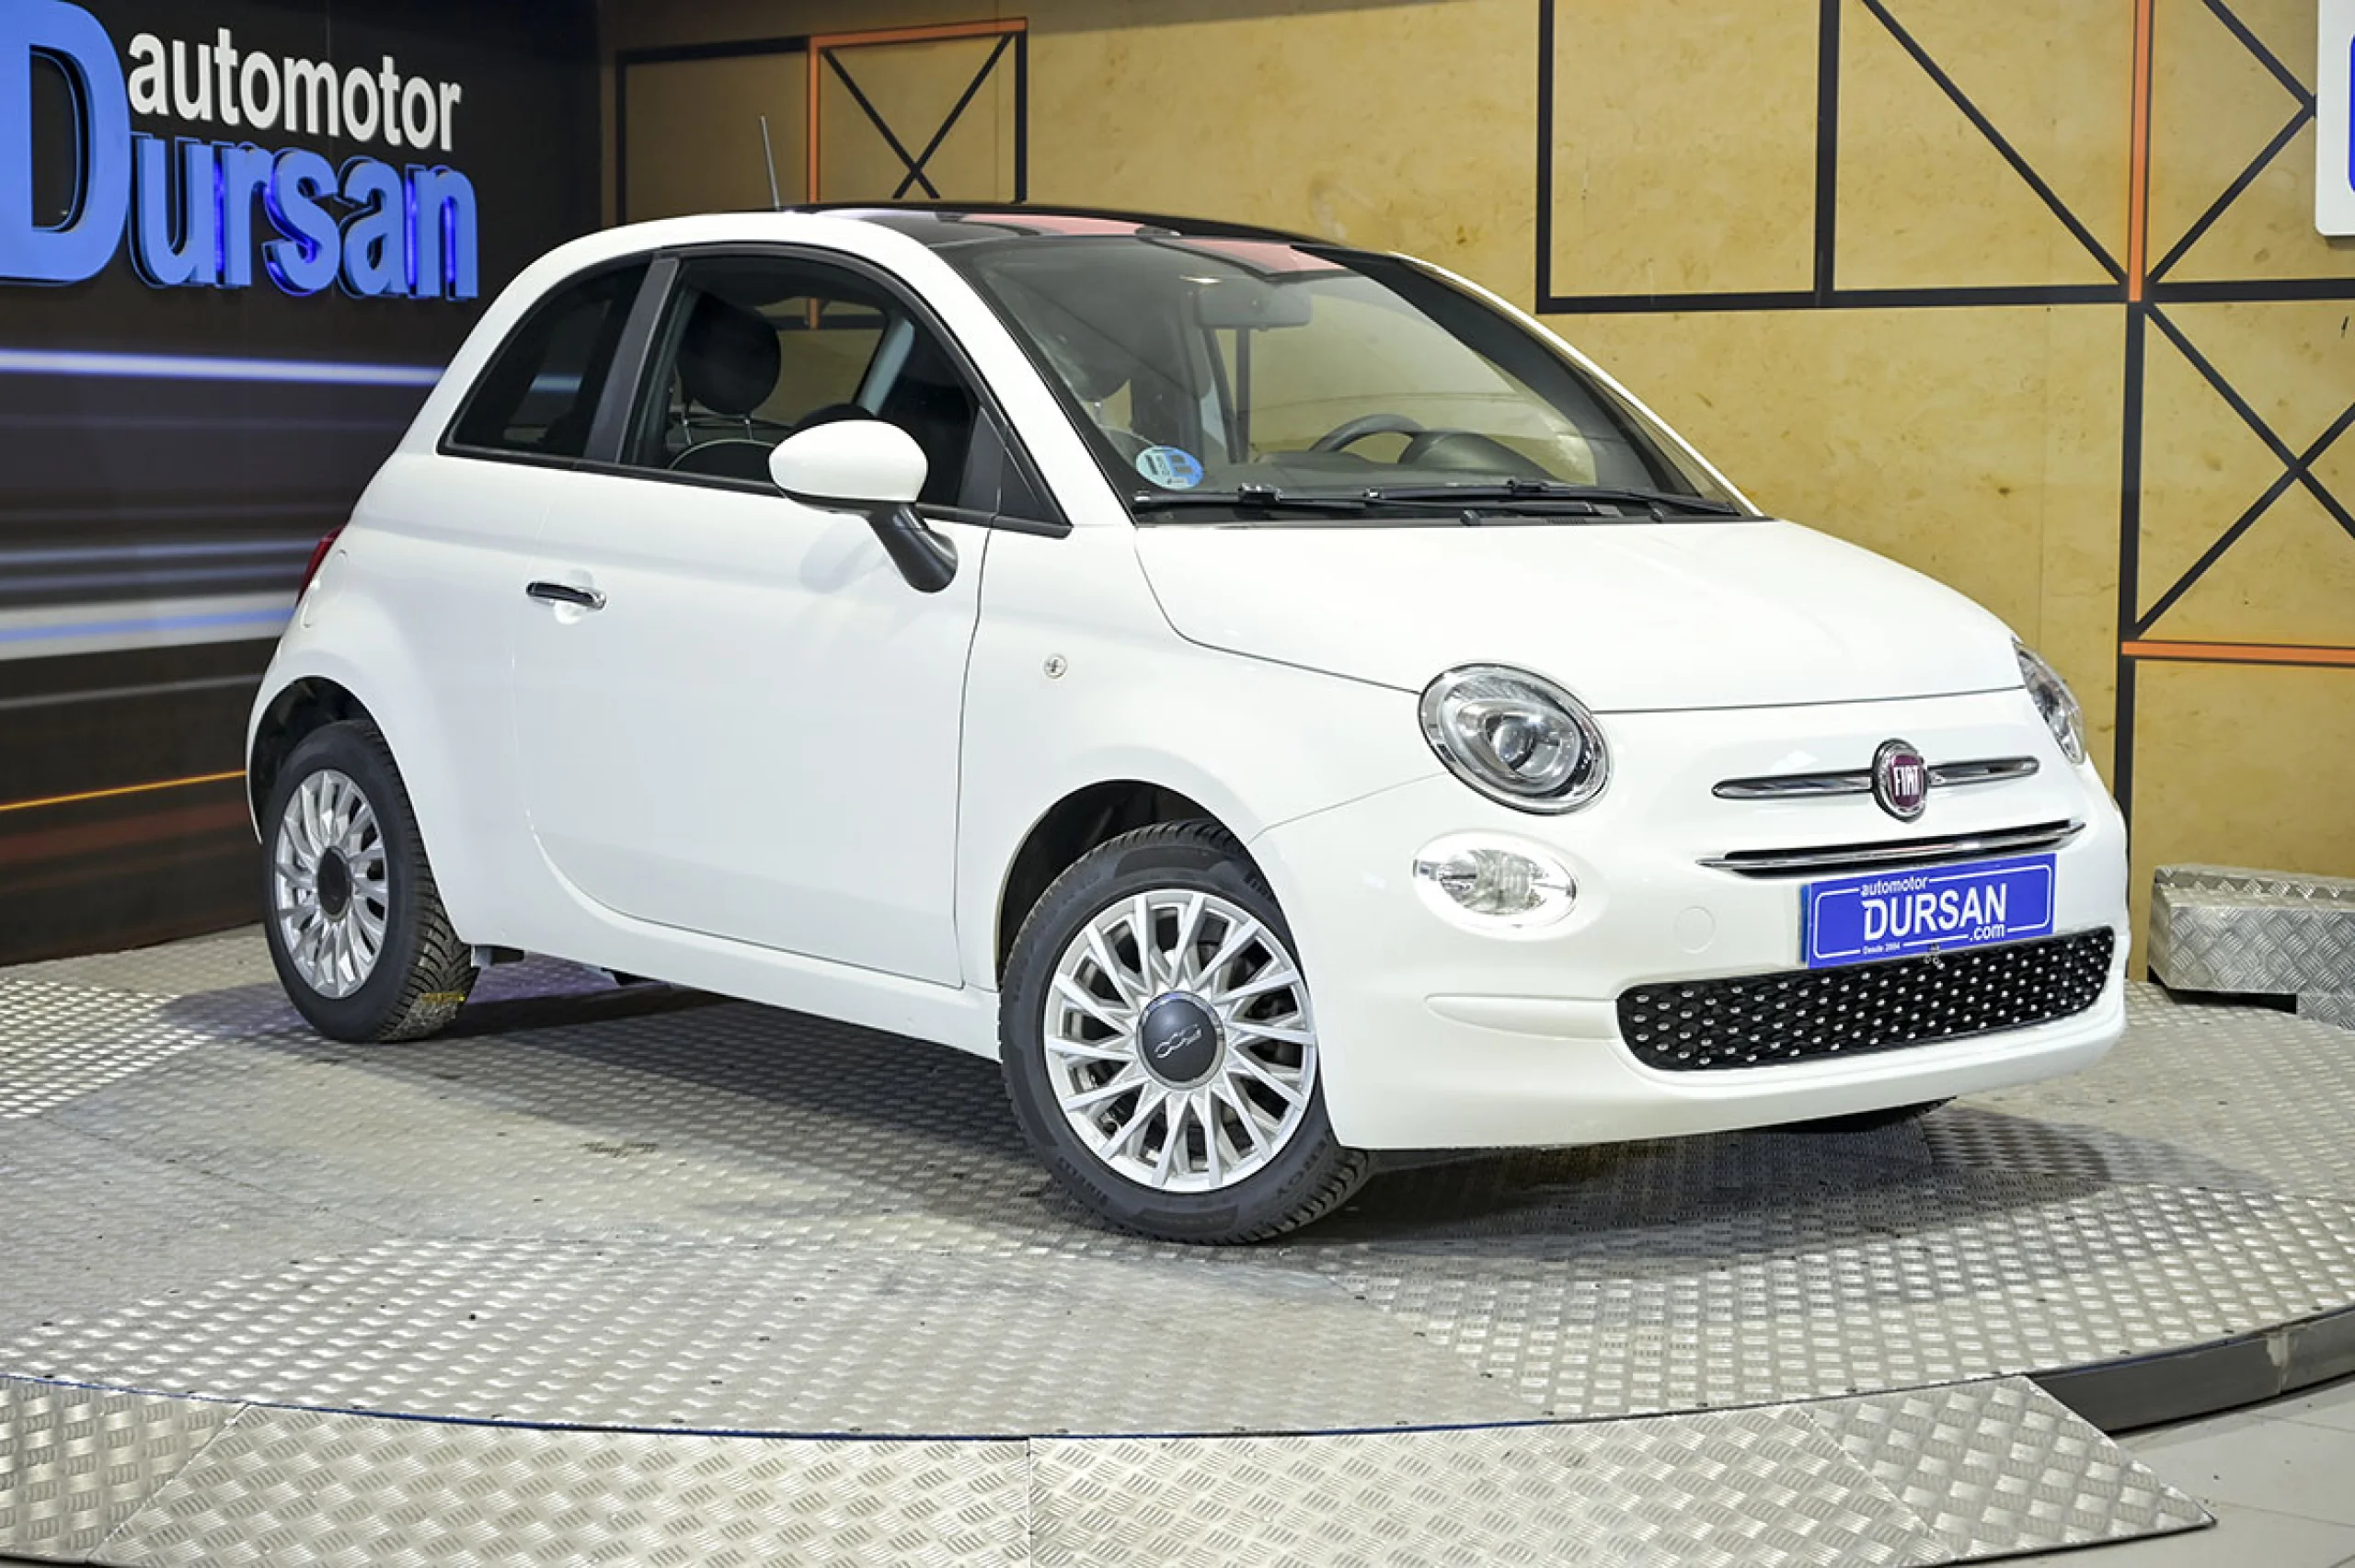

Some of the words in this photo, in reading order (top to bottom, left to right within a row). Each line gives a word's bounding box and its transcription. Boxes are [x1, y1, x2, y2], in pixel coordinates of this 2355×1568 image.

[127, 28, 462, 152] automotor
[0, 0, 478, 301] Dursan
[1893, 765, 1919, 796] FIAT
[1860, 876, 1930, 898] automotor
[1861, 883, 2007, 942] DURSAN
[1970, 921, 2006, 943] .com
